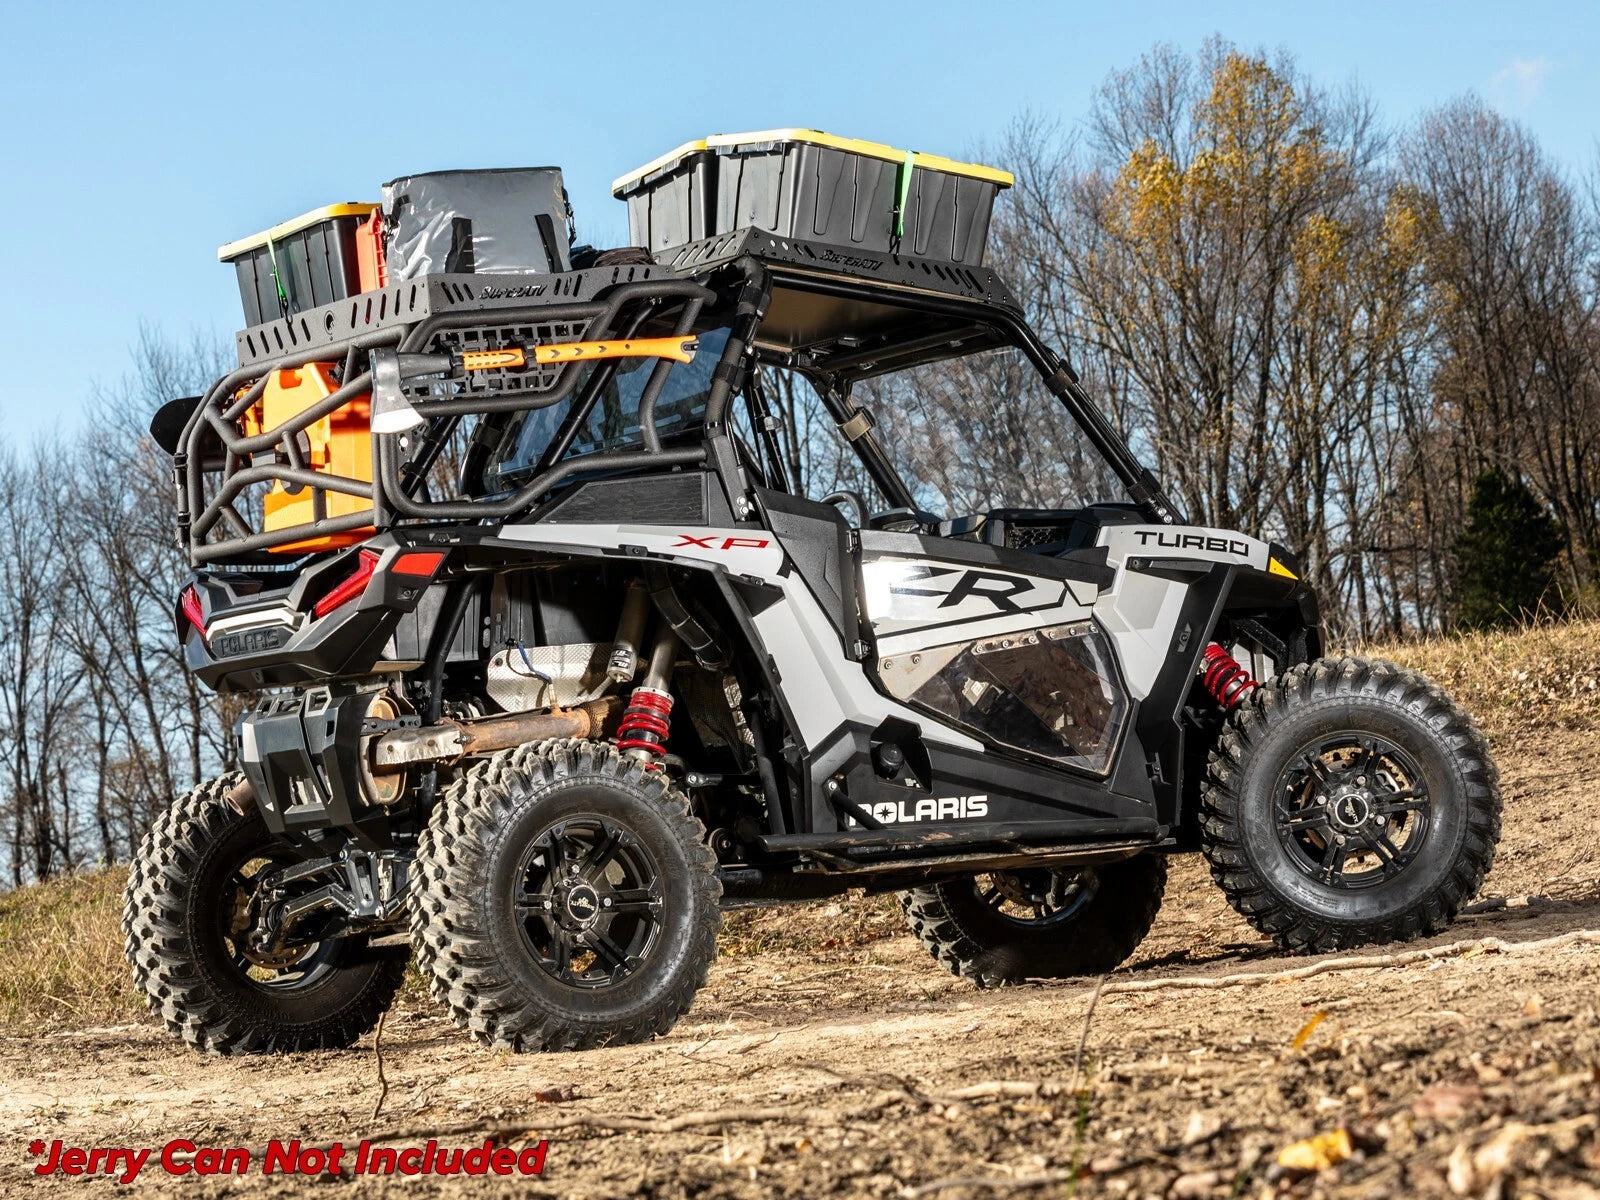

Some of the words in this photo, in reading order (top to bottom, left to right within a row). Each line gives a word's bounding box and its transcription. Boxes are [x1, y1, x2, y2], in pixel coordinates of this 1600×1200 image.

[670, 534, 770, 550] XP
[1133, 530, 1249, 557] TURBO
[220, 629, 280, 657] POLARIS
